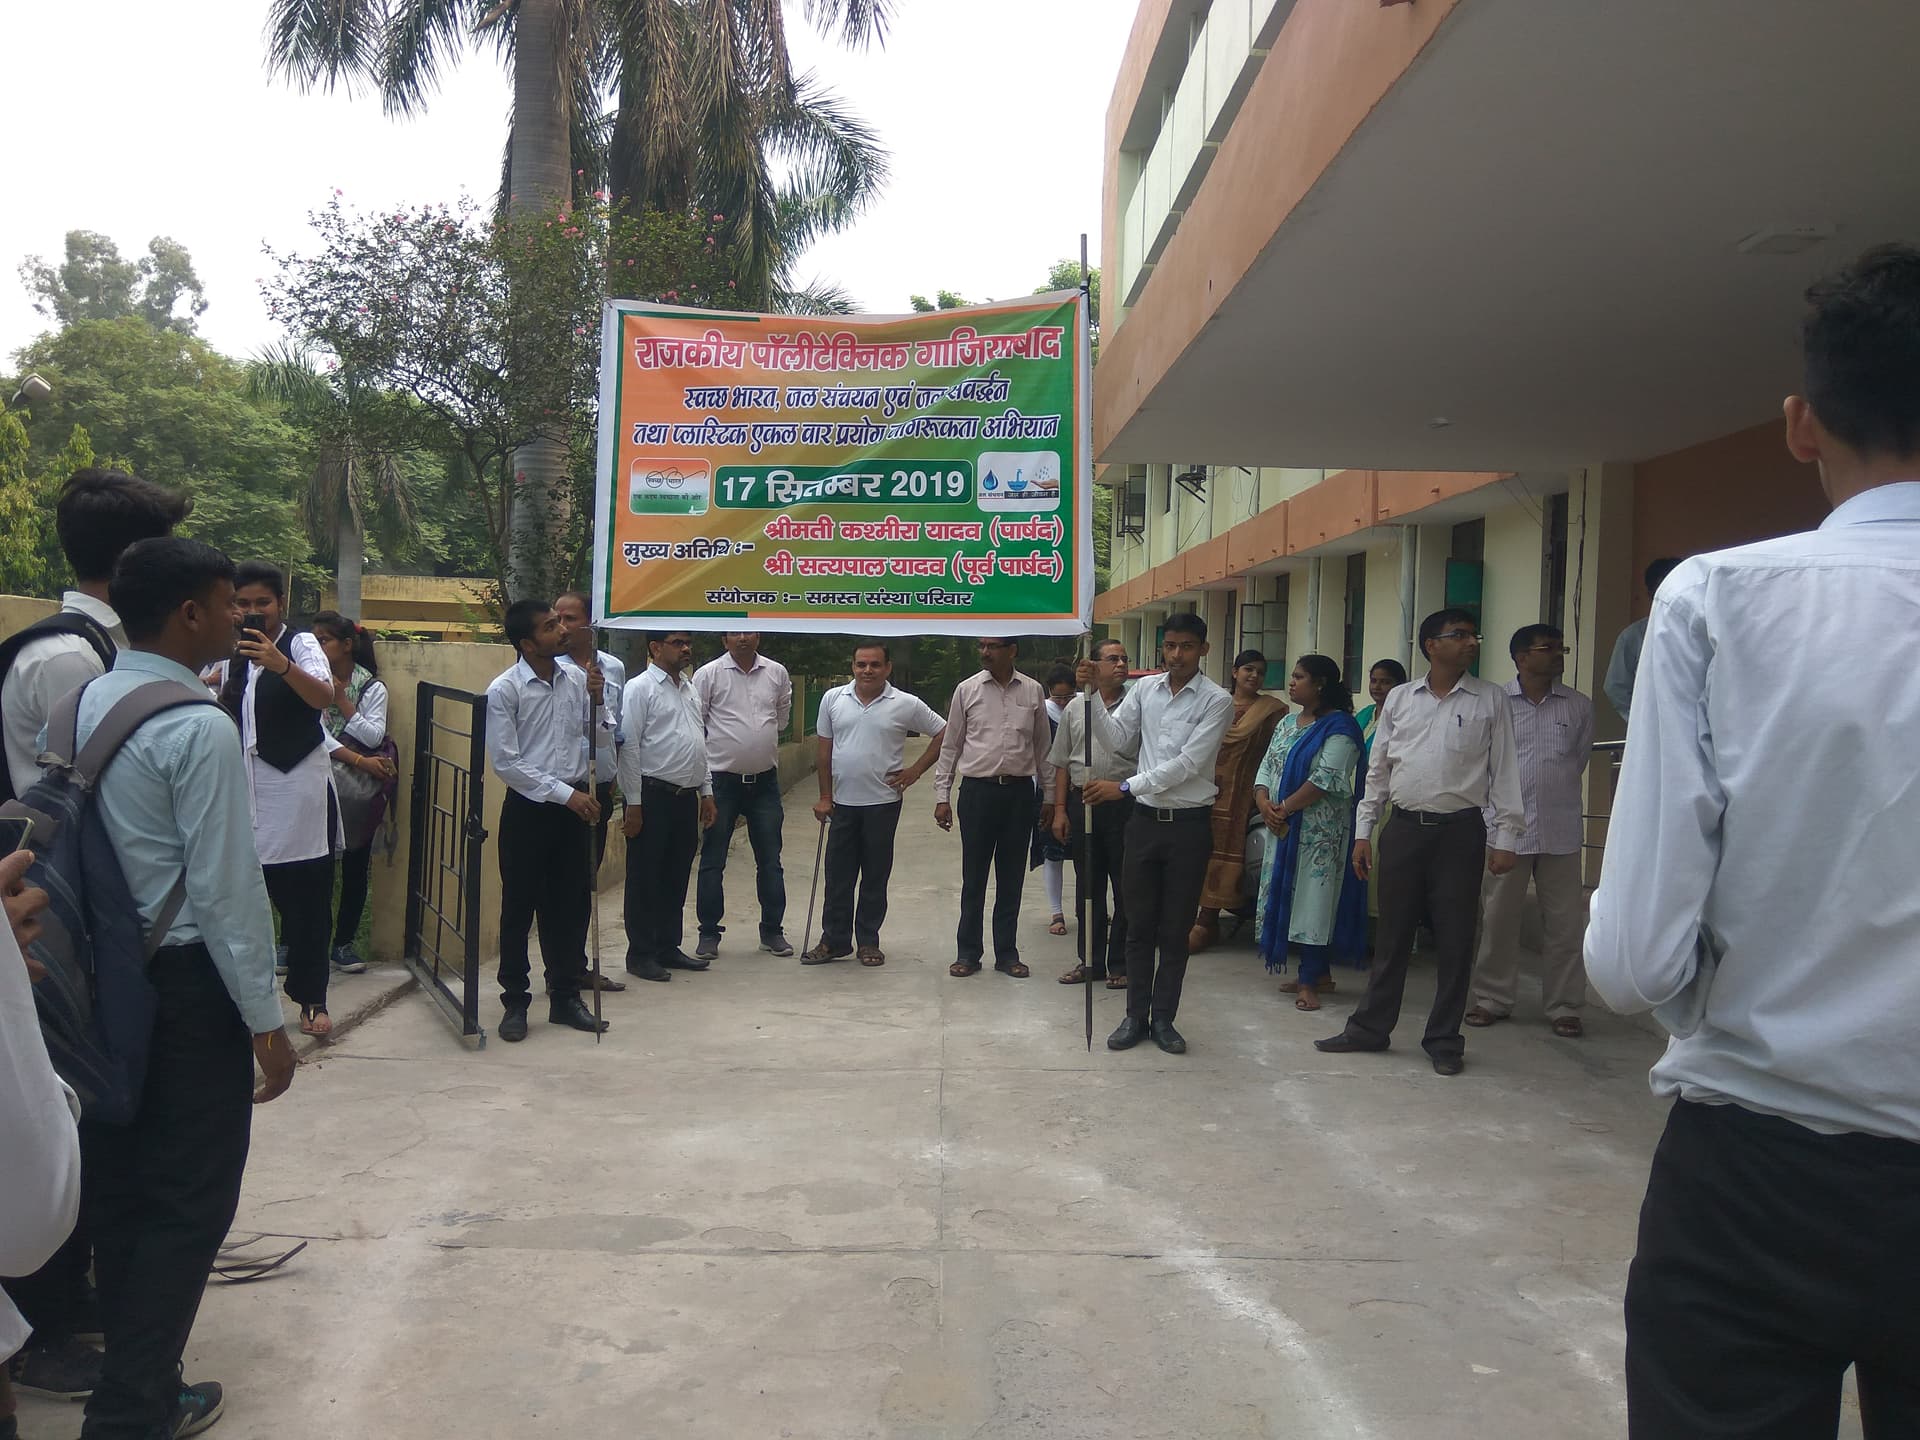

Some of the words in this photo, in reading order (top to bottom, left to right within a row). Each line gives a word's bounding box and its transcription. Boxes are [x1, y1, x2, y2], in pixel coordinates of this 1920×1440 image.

[635, 330, 745, 370] राजकीय
[751, 333, 910, 371] पॉलीटेक्निक
[684, 386, 728, 410] स्वच्छ
[732, 384, 779, 411] भारत,
[785, 387, 818, 408] जल
[821, 381, 880, 408] संचयन
[884, 380, 914, 417] एवं
[633, 424, 668, 445] तथा
[672, 417, 748, 445] प्लास्टिक
[751, 423, 798, 453] एकल
[801, 424, 833, 445] वार
[835, 415, 886, 447] प्रयोग
[982, 409, 1059, 439] अभियान
[721, 475, 755, 502] 17
[891, 469, 964, 498] 2019
[764, 515, 834, 542] श्रीमती
[840, 515, 920, 541] कश्मीरा
[927, 522, 982, 542] यादव
[990, 514, 1064, 546] (पार्षद)
[624, 542, 671, 569] मुख्य
[764, 552, 793, 577] श्री
[798, 556, 886, 577] सत्यपाल
[890, 556, 945, 577] यादव
[953, 551, 994, 582] (पूर्व
[999, 551, 1064, 582] पार्षद)
[706, 589, 777, 605] संयोजक
[806, 590, 862, 605] समस्त
[866, 587, 911, 605] संस्था
[916, 589, 973, 605] परिवार
